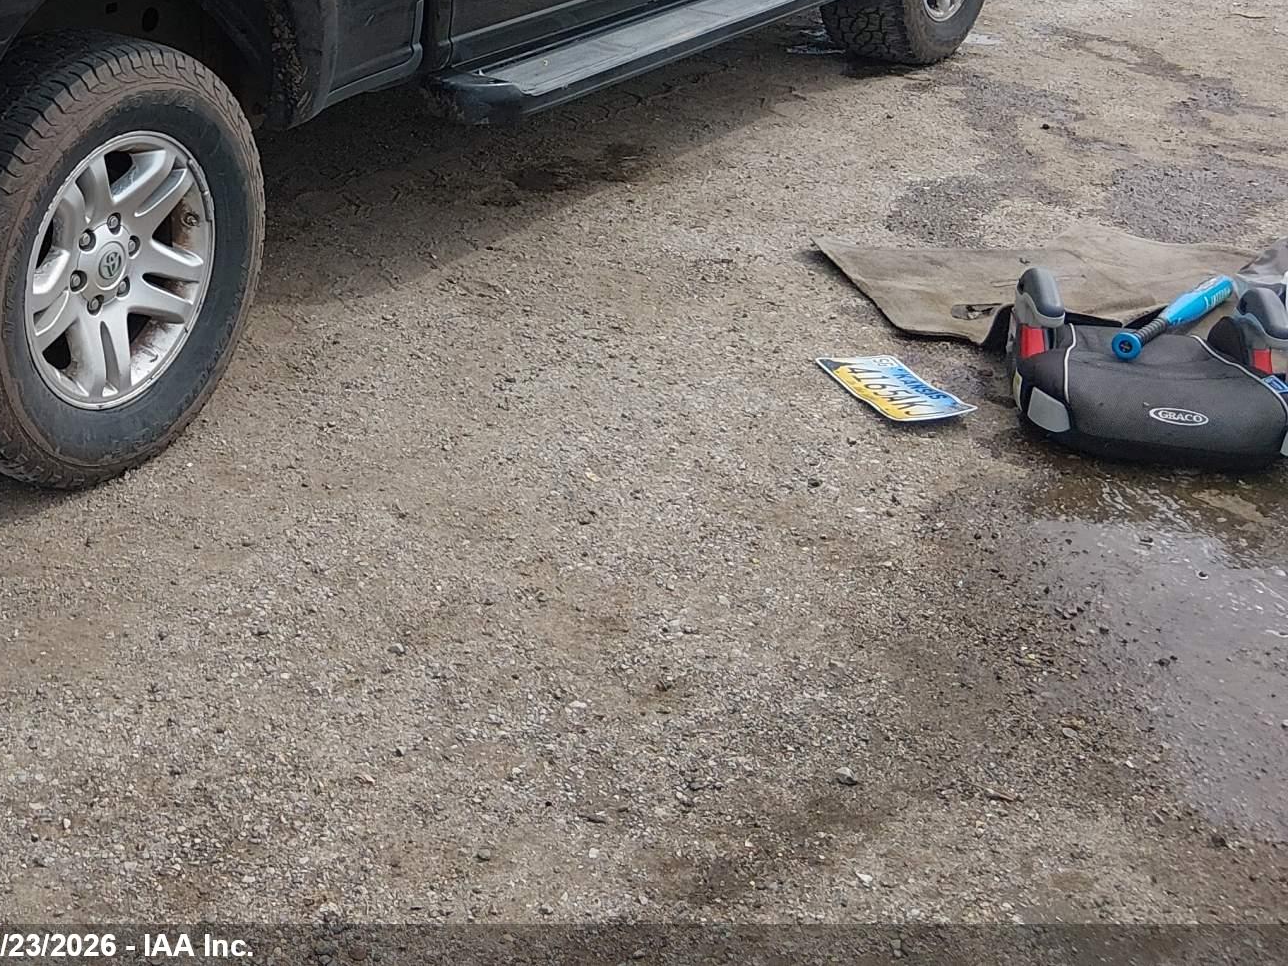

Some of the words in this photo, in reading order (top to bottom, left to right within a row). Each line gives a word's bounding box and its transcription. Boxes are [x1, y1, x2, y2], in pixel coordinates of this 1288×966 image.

[847, 367, 945, 416] 4165AKJ
[893, 368, 947, 400] KANSAS
[1157, 410, 1203, 423] GRACO
